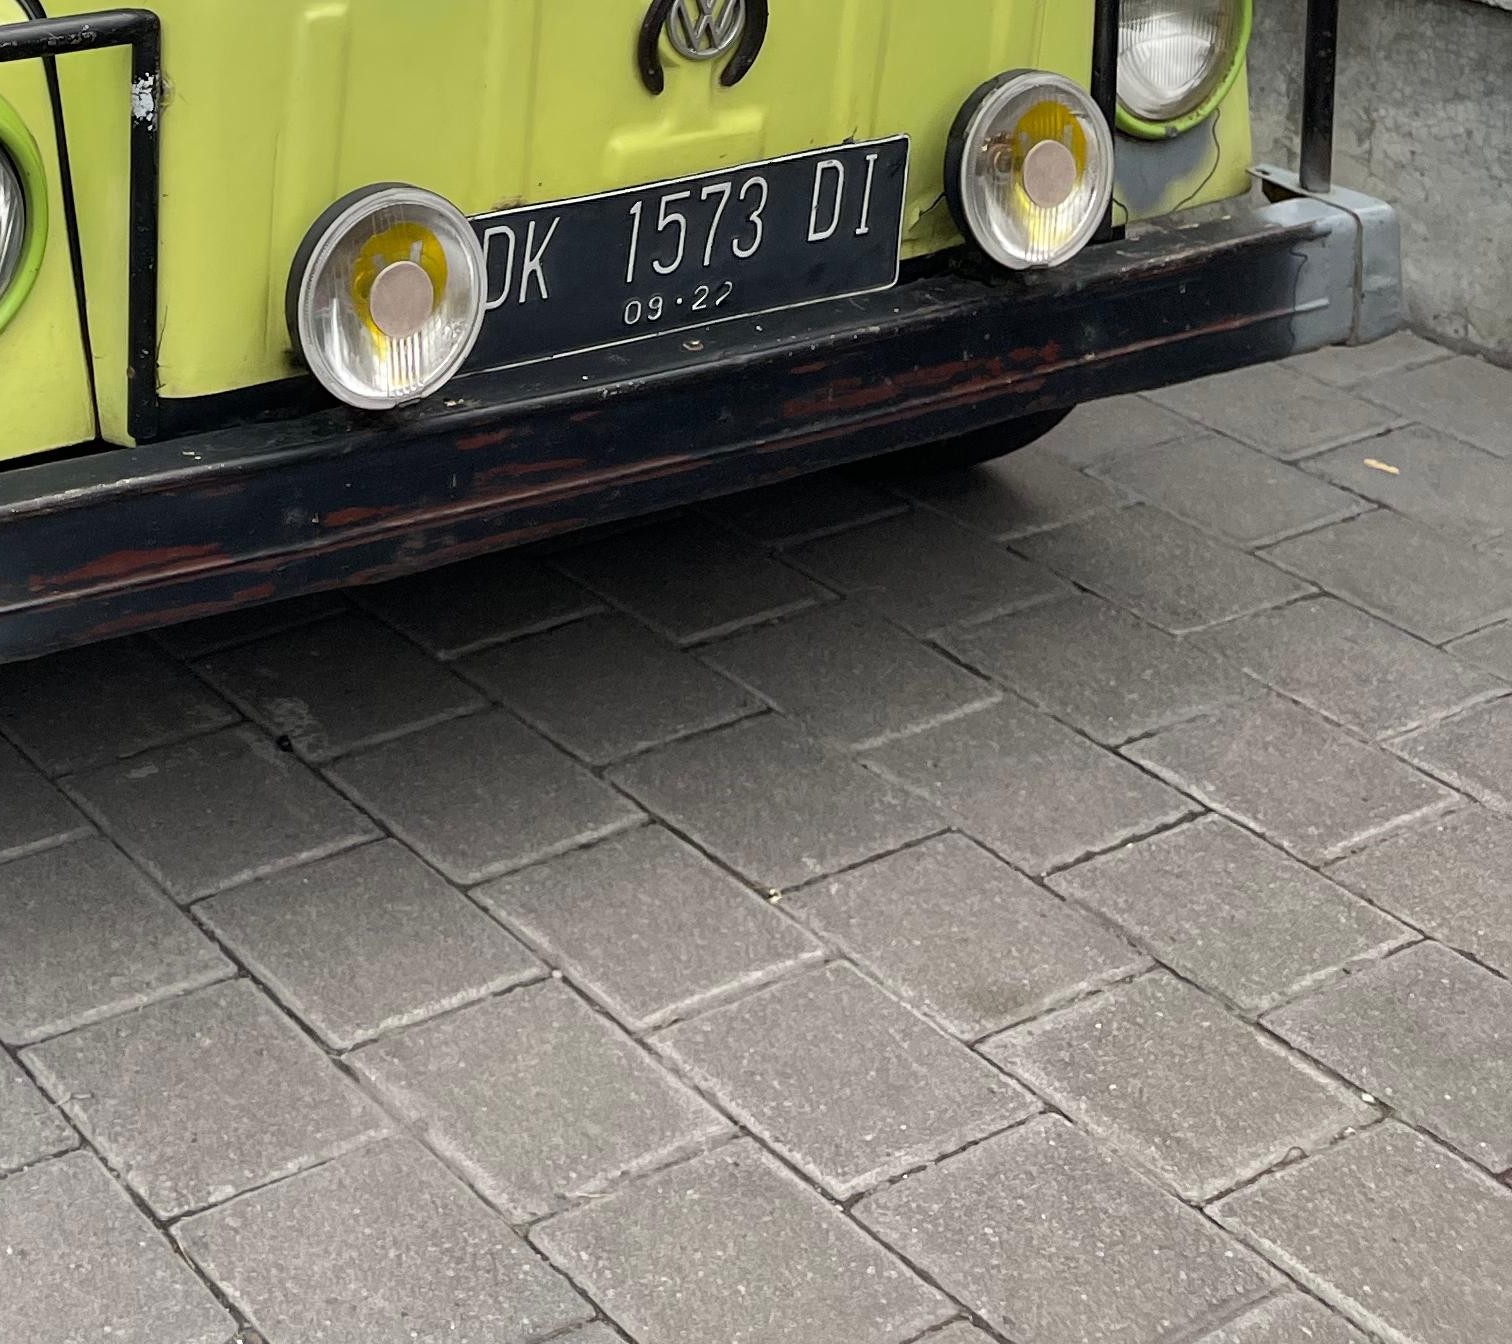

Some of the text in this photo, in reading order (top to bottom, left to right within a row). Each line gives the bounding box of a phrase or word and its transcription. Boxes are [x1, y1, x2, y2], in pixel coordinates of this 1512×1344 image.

[483, 153, 879, 311] DK 1573 DI
